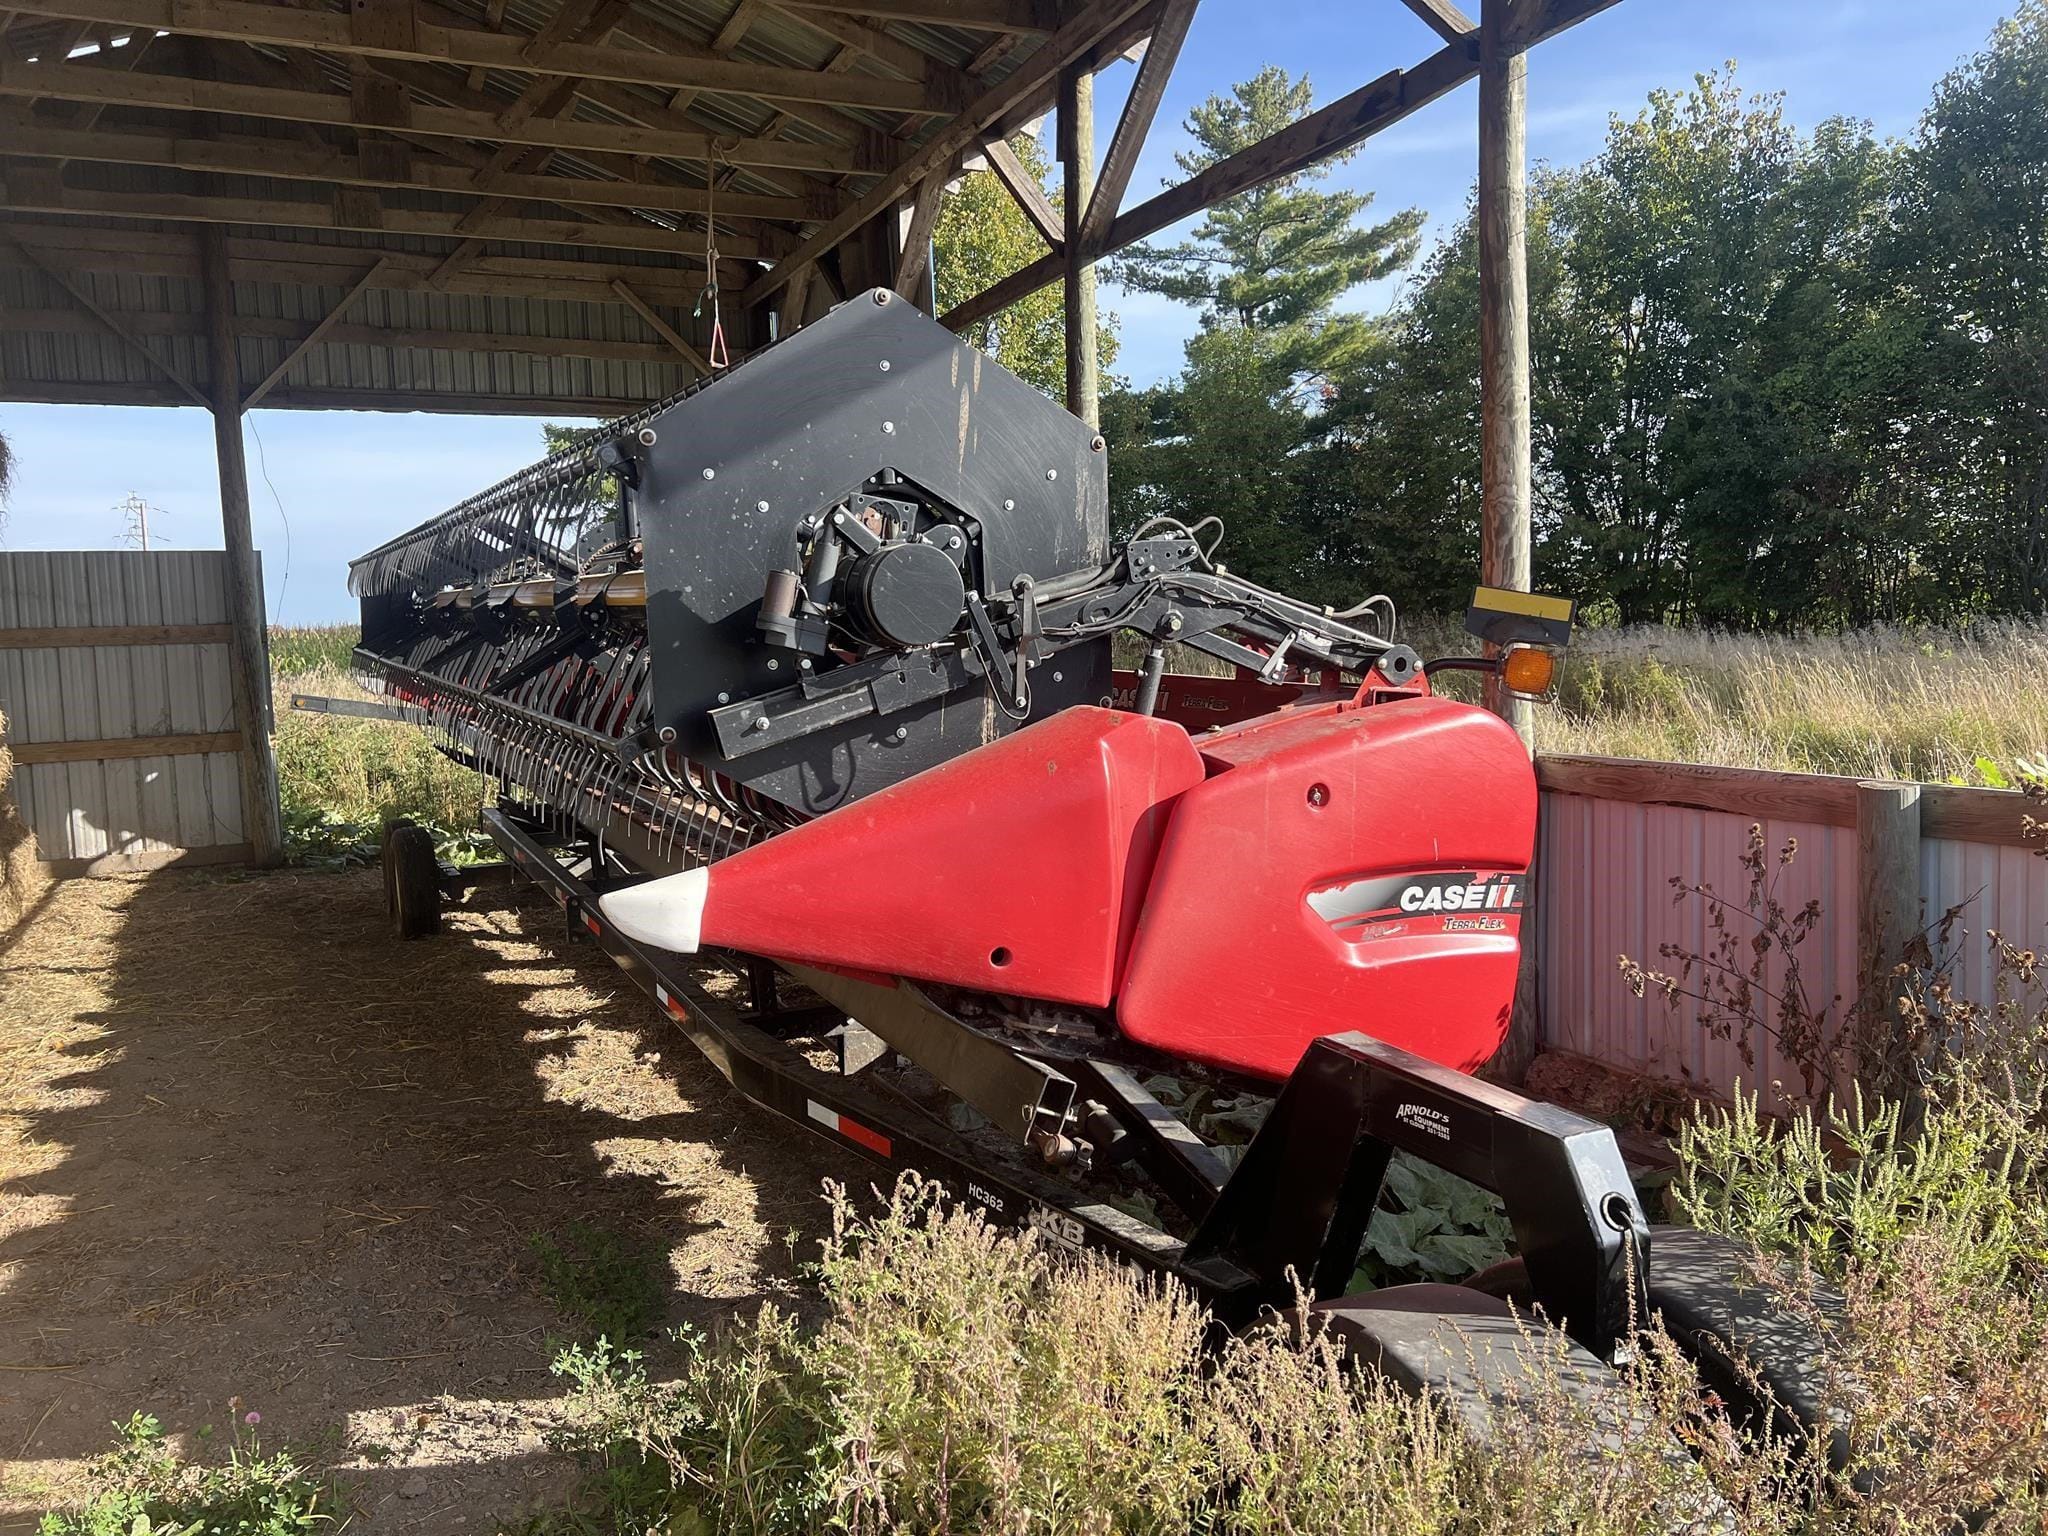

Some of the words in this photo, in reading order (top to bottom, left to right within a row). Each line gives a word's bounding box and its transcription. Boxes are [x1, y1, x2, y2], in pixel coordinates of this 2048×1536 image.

[1445, 917, 1476, 930] TERRA
[1478, 916, 1503, 930] FLEX
[1396, 1103, 1450, 1123] ARNOLD'S
[1414, 1115, 1450, 1134] EQUIPMENT
[968, 1182, 1004, 1212] HC362
